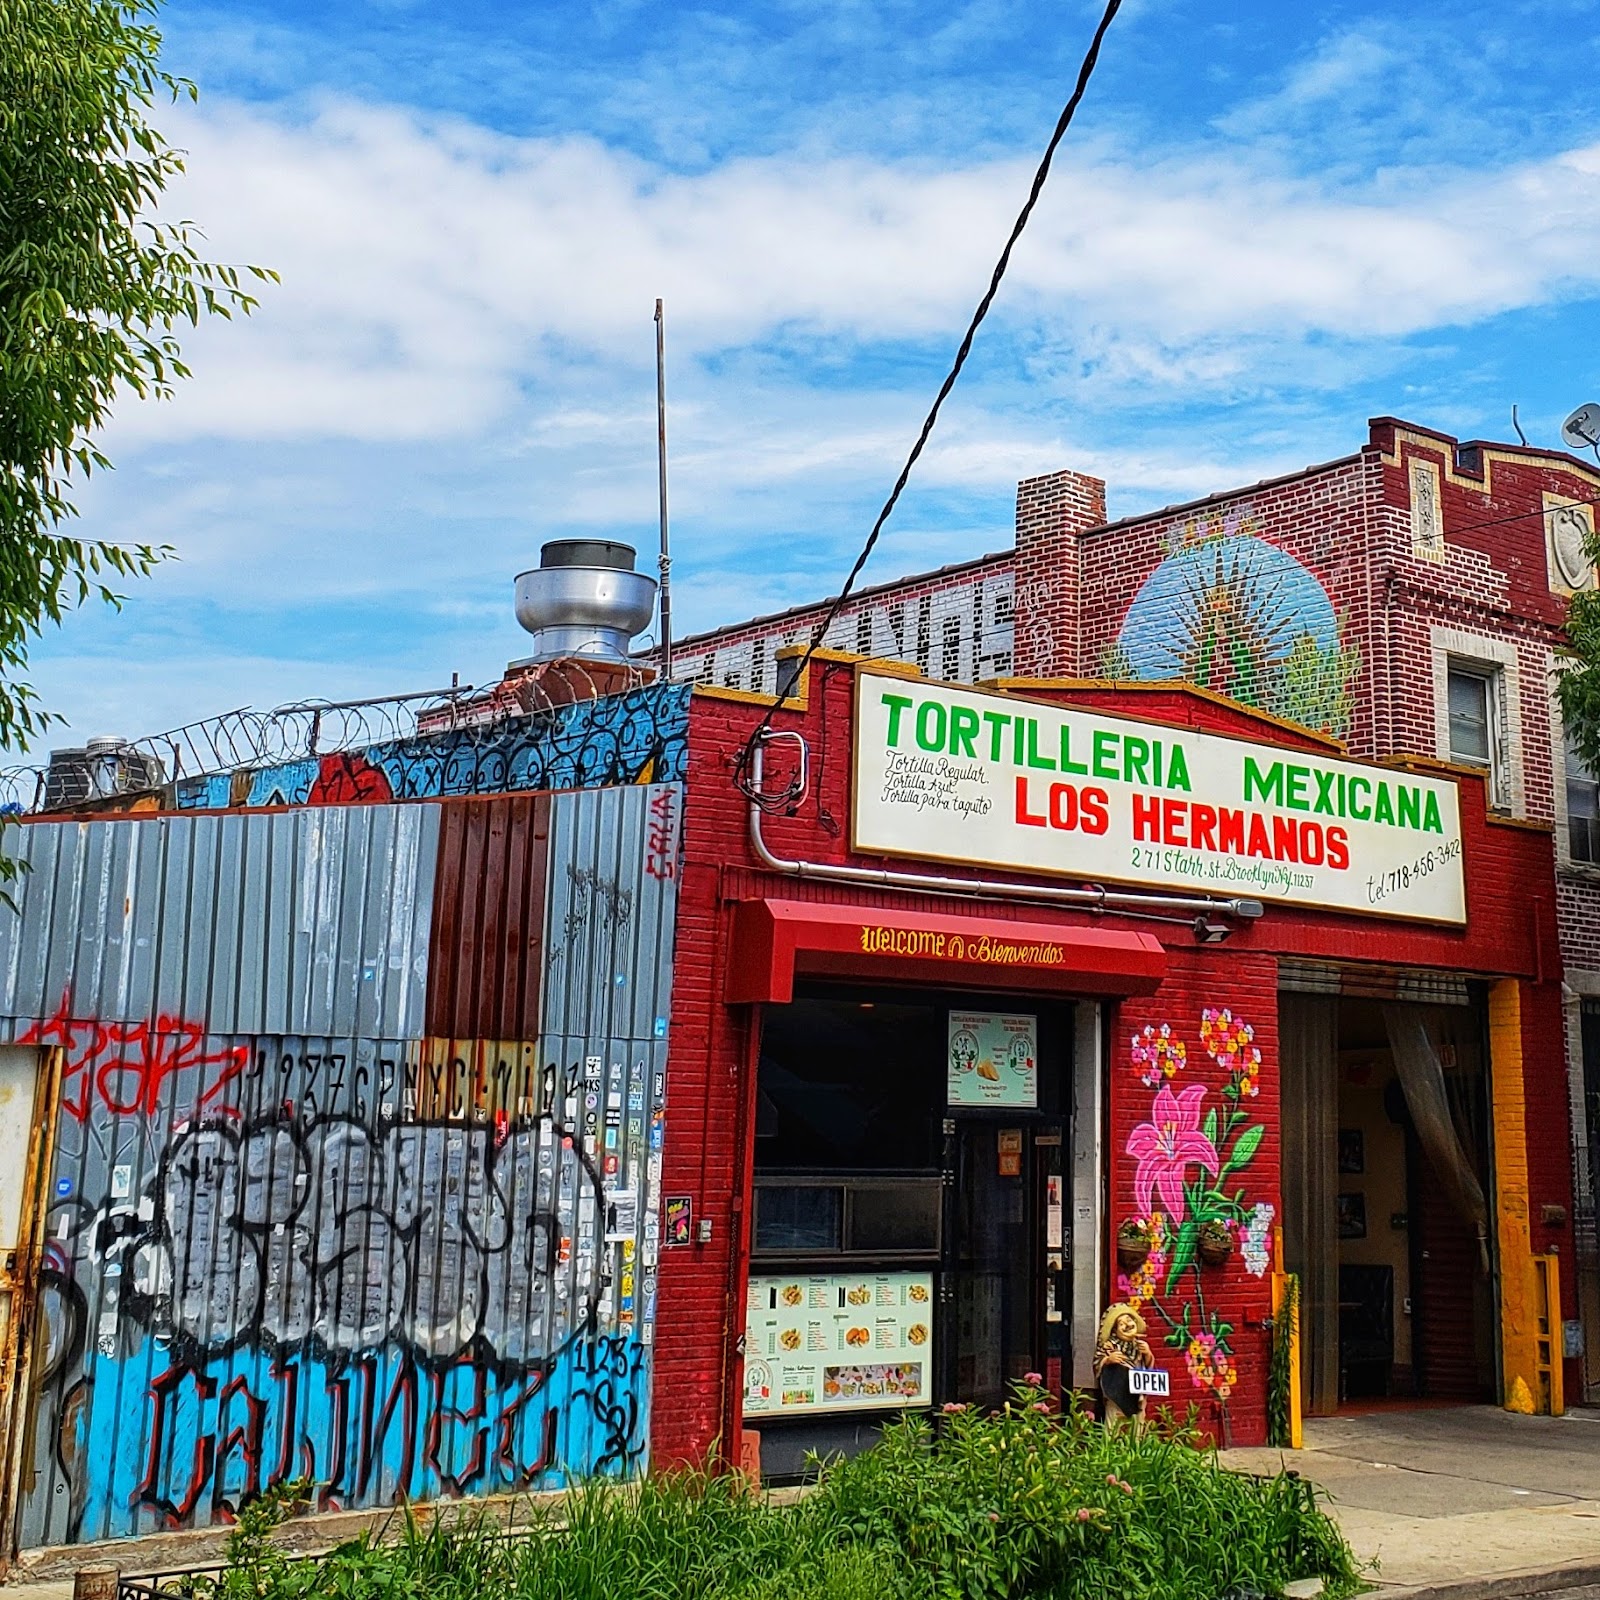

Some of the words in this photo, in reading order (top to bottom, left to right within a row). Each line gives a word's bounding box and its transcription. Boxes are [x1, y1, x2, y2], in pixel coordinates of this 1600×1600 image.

[881, 693, 1192, 792] TORTILLERIA
[1244, 756, 1444, 835] MEXICANA
[886, 750, 934, 776] Tortilla
[885, 769, 926, 791] Tortilla
[881, 787, 920, 805] Tortilla
[917, 793, 950, 812] para
[953, 795, 992, 820] taquito
[1015, 776, 1109, 836] LOS
[1132, 793, 1349, 871] HERMANOS
[1131, 847, 1161, 870] 271
[1388, 838, 1461, 893] 718-456-3422
[1133, 1372, 1166, 1392] OPEN
